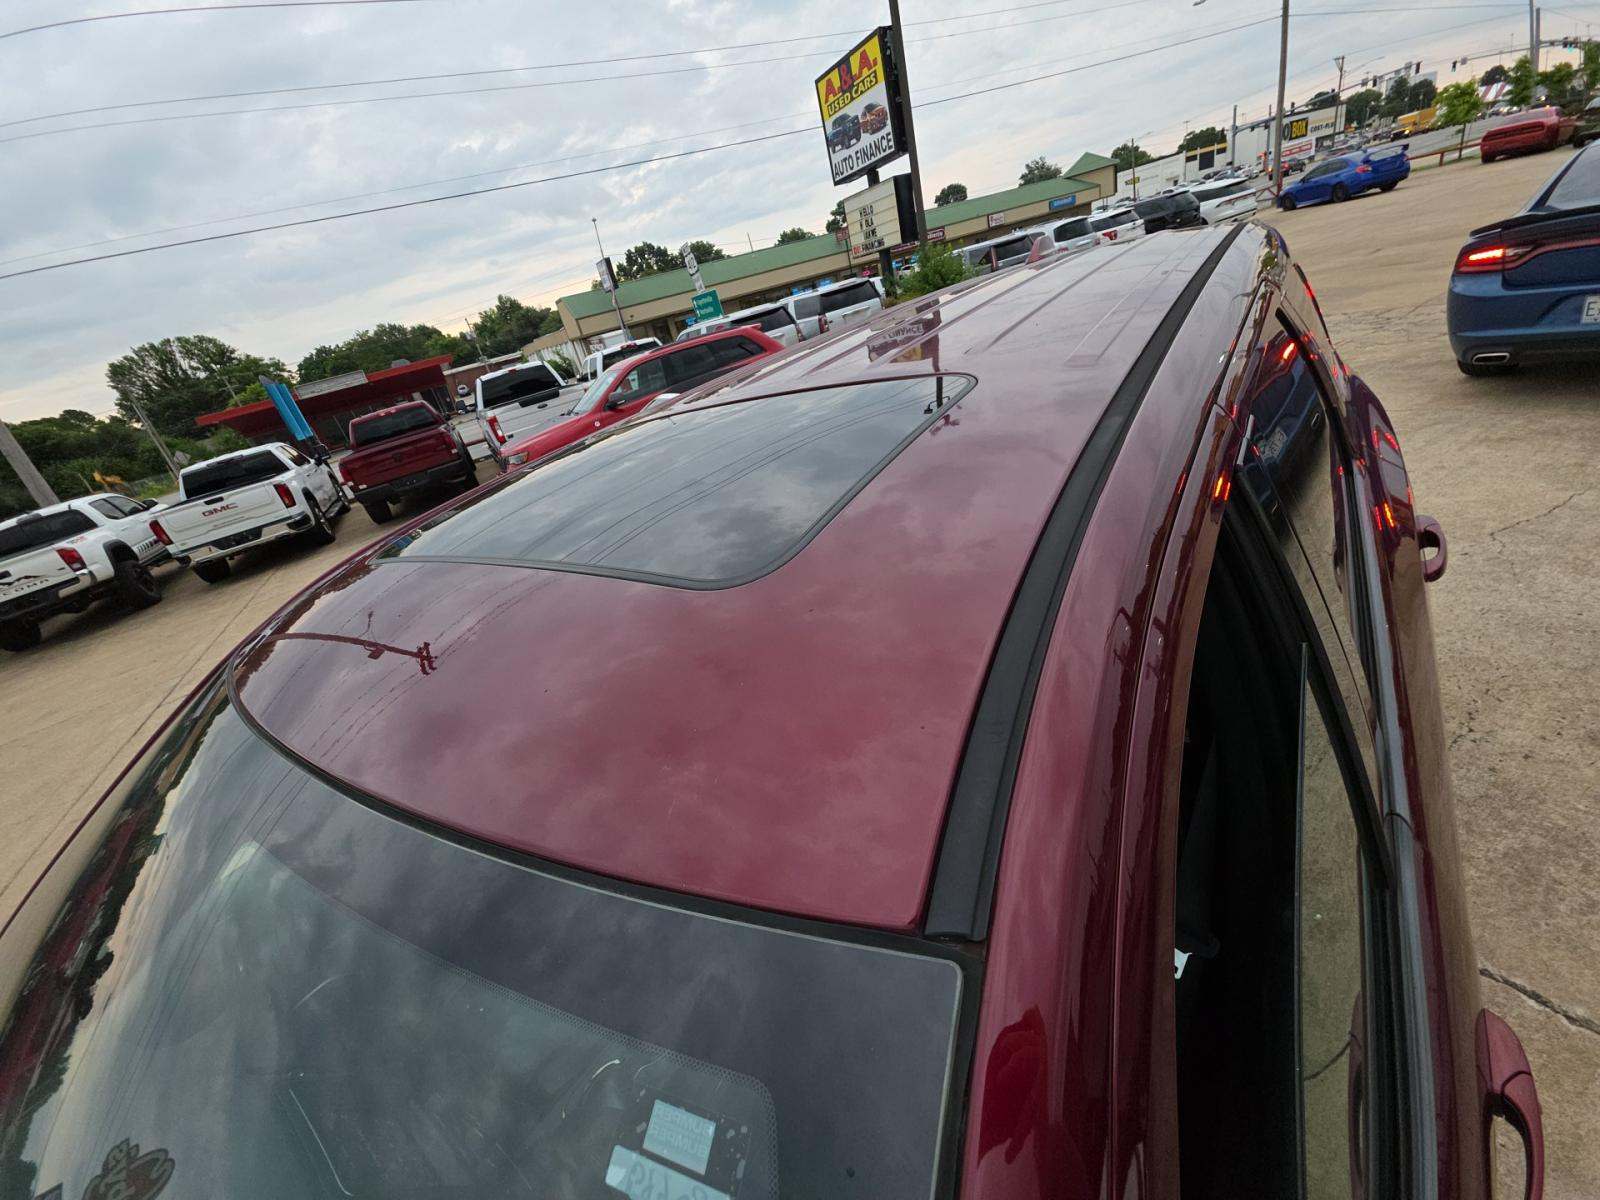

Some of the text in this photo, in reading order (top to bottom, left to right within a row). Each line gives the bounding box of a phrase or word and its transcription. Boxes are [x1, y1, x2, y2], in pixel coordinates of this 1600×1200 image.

[828, 72, 877, 114] USED CARS
[1291, 119, 1308, 139] BOX
[834, 132, 894, 178] AUTO FINANCE
[859, 204, 874, 218] HELLO
[201, 502, 239, 517] GMC
